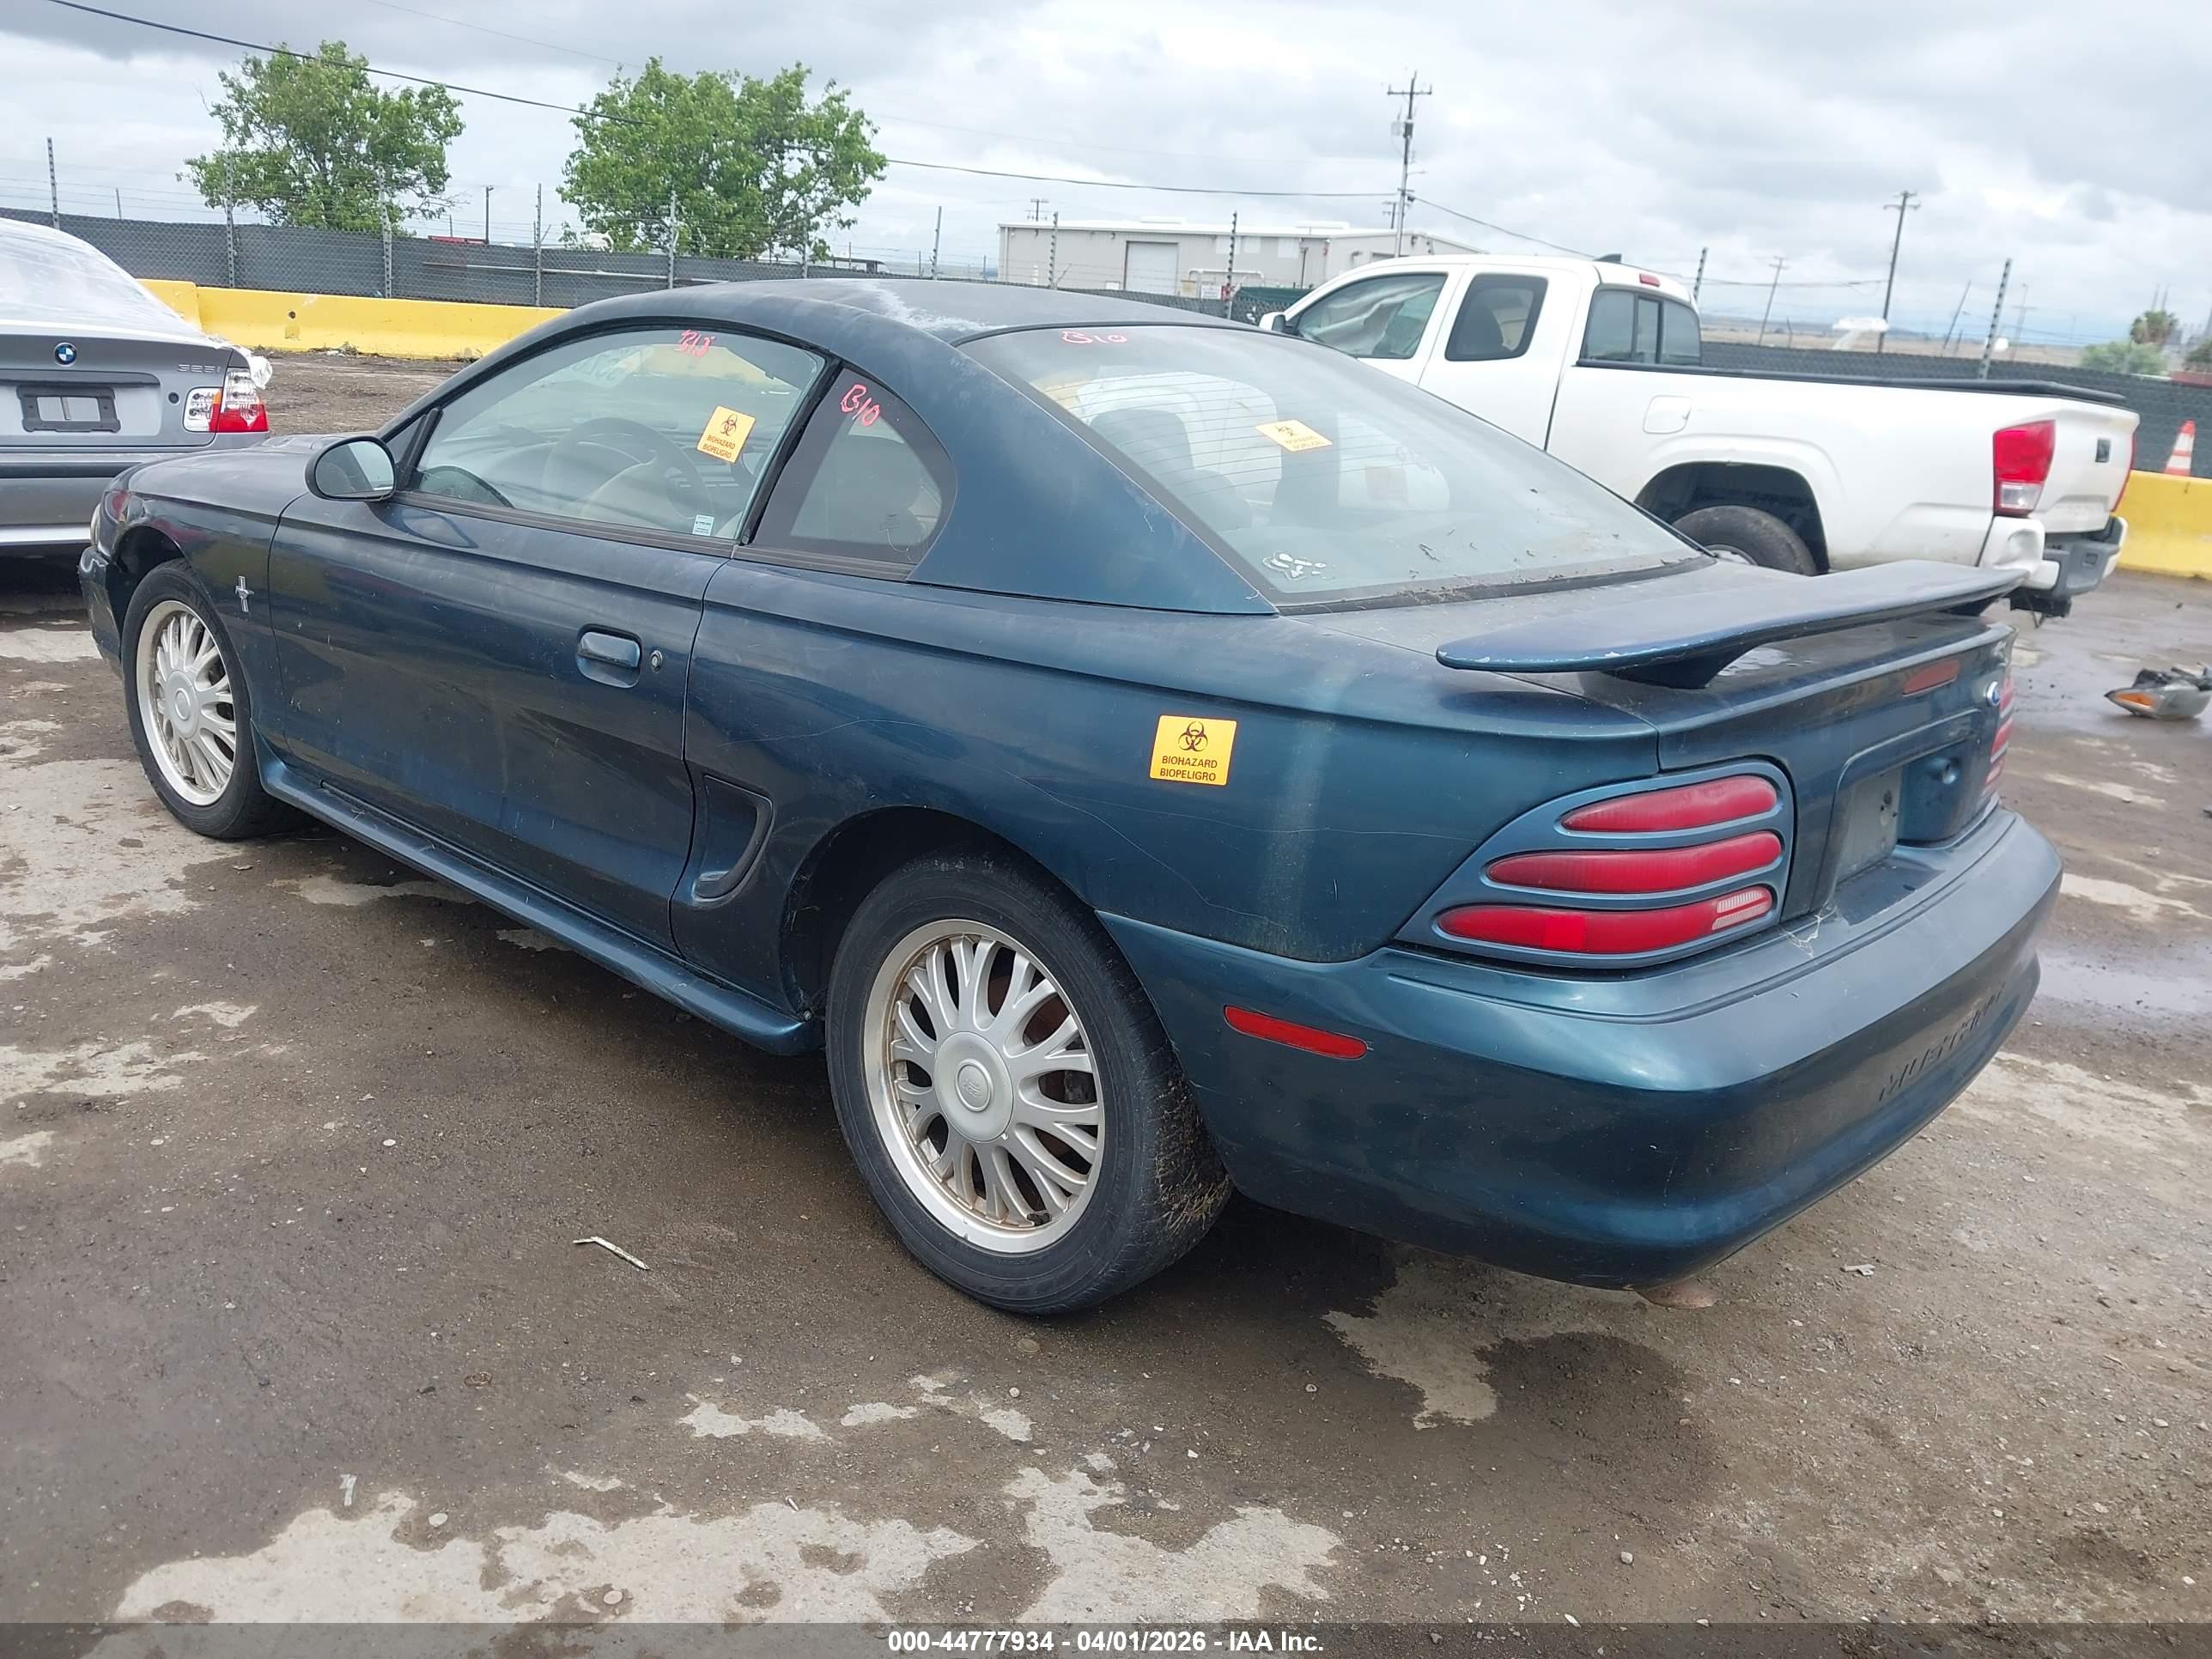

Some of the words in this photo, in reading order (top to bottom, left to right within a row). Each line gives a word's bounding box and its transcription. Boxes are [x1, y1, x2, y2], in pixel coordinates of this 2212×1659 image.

[841, 384, 879, 426] BIO
[707, 434, 736, 450] BIOHAZARD
[702, 443, 732, 459] BIOPELIGRO
[1162, 756, 1218, 769] BIOHAZARD
[1159, 768, 1216, 781] BIOPELIGRO
